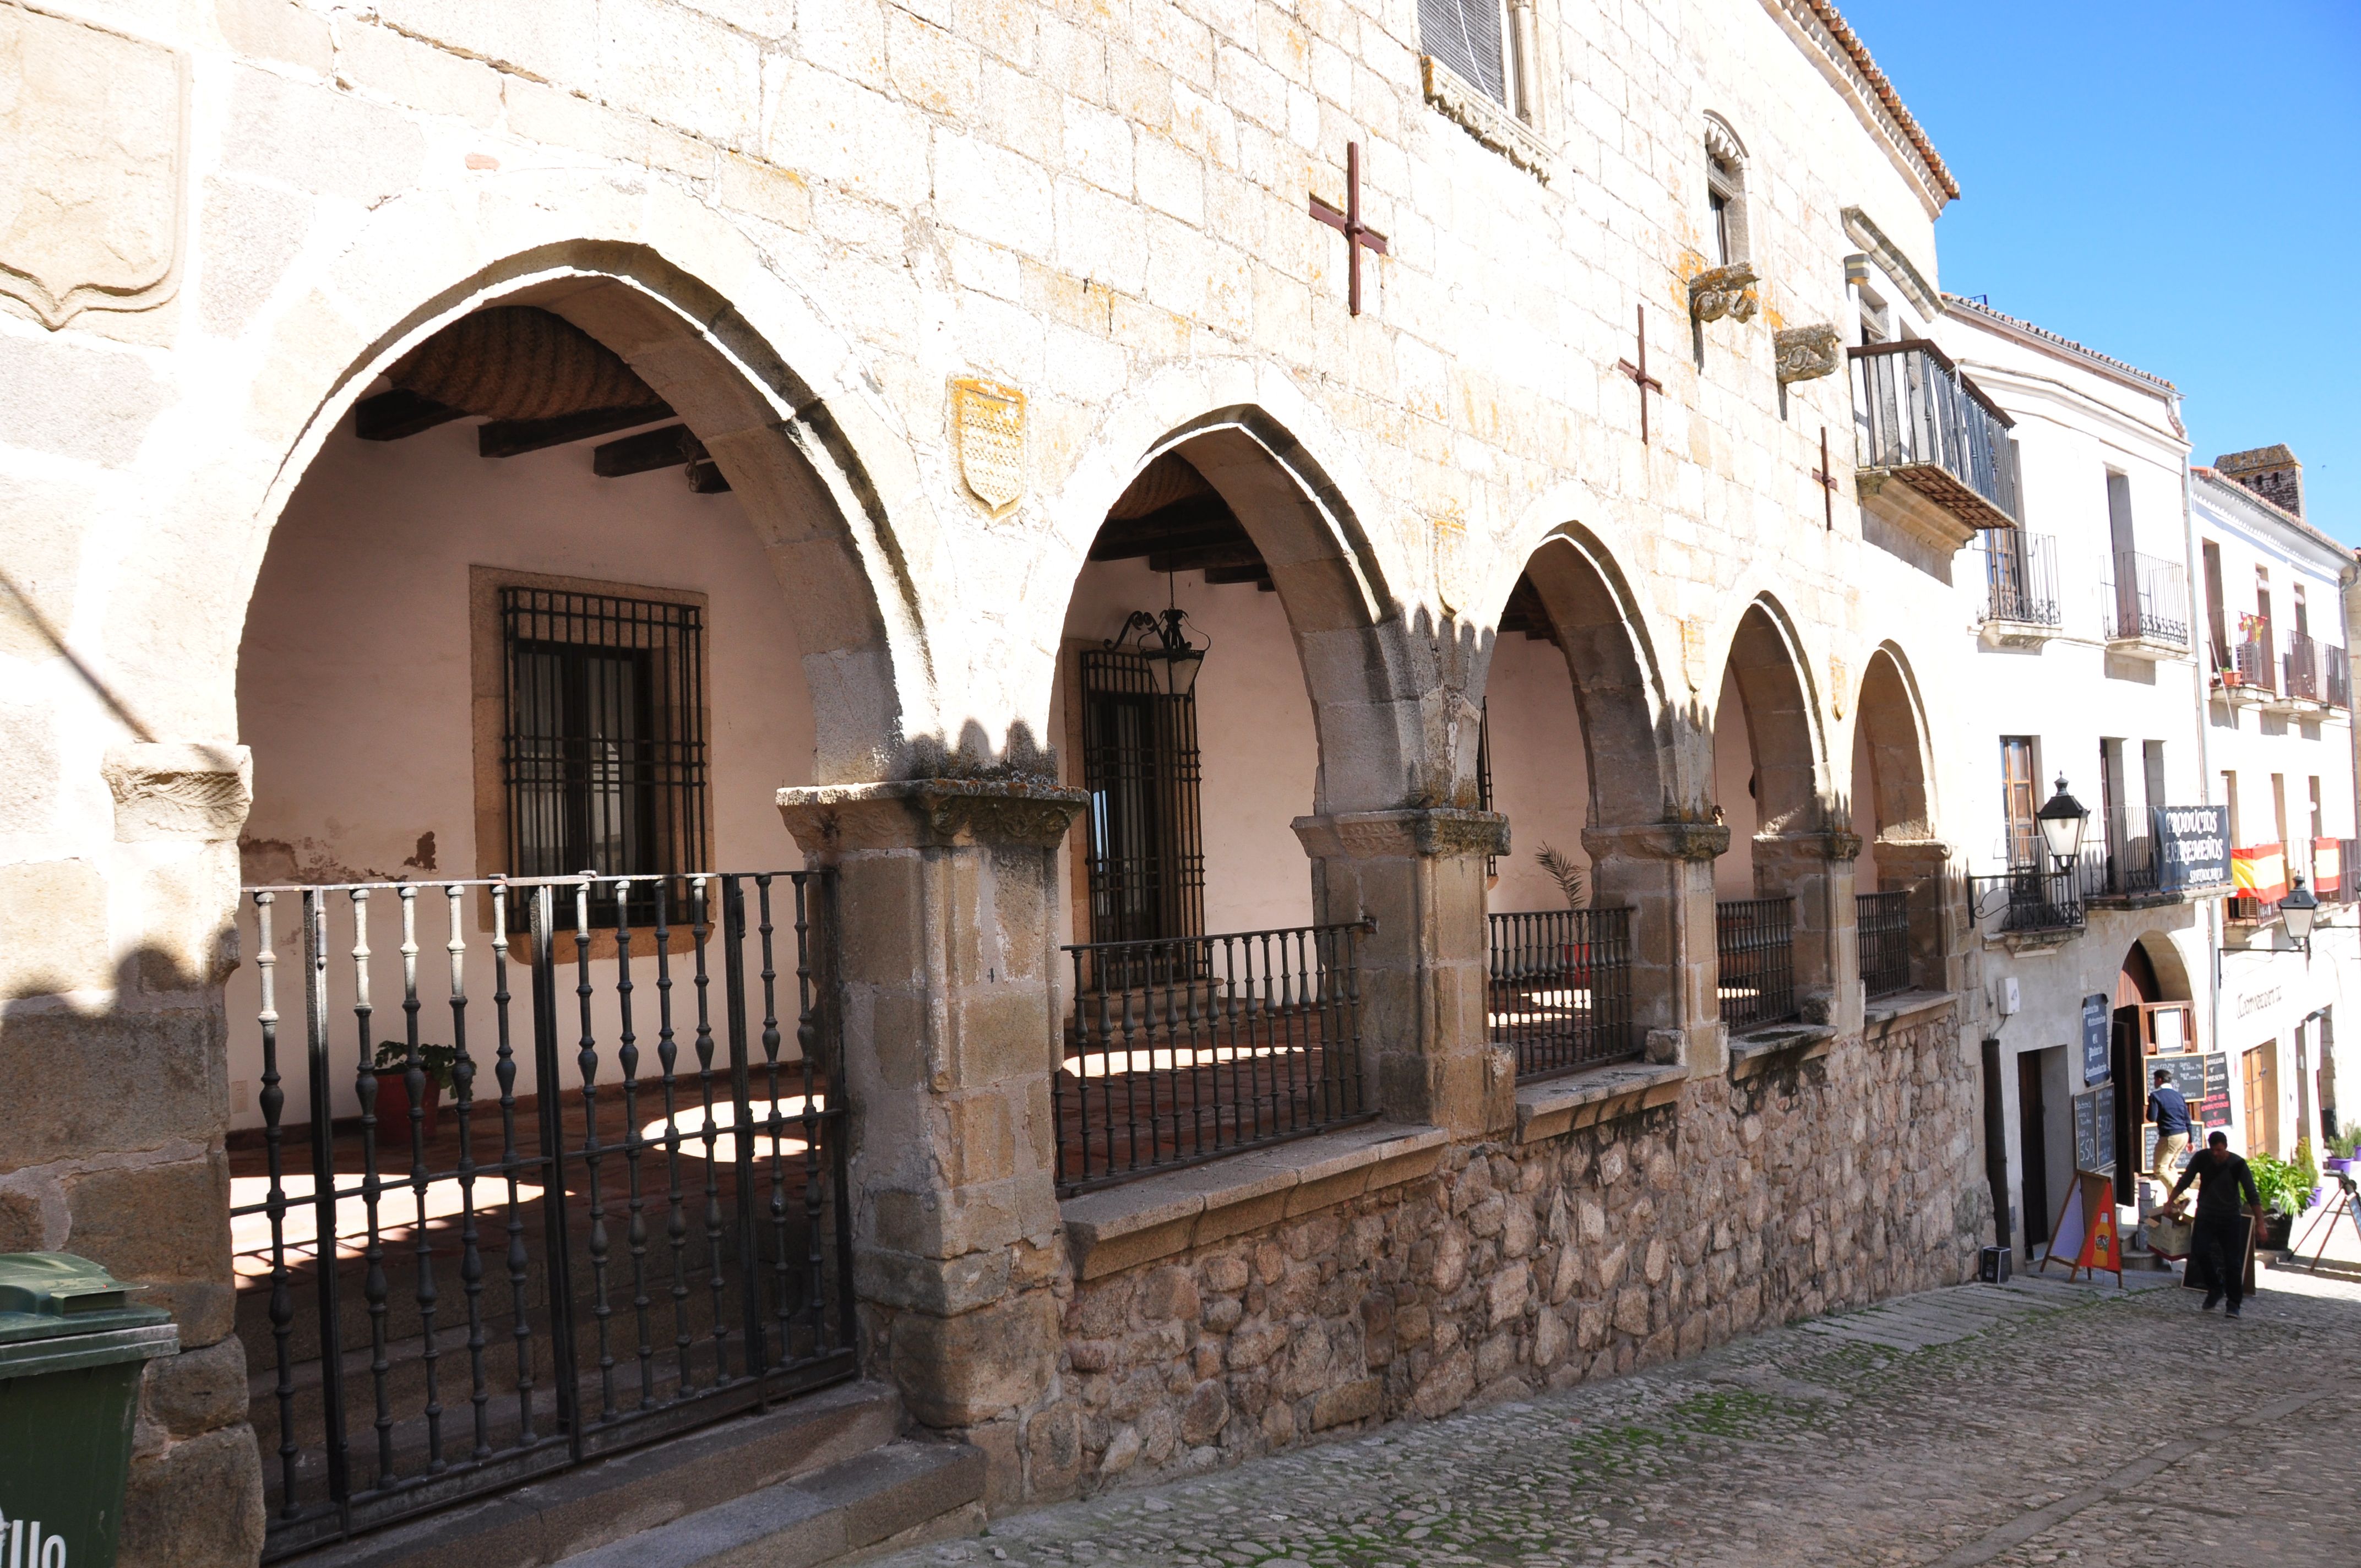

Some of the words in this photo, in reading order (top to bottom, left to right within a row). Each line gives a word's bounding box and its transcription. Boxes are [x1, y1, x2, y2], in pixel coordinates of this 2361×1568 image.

[2166, 809, 2217, 837] PRODUCTOS
[2165, 835, 2223, 865] EXTREMEÑOS
[0, 1519, 66, 1568] llo
